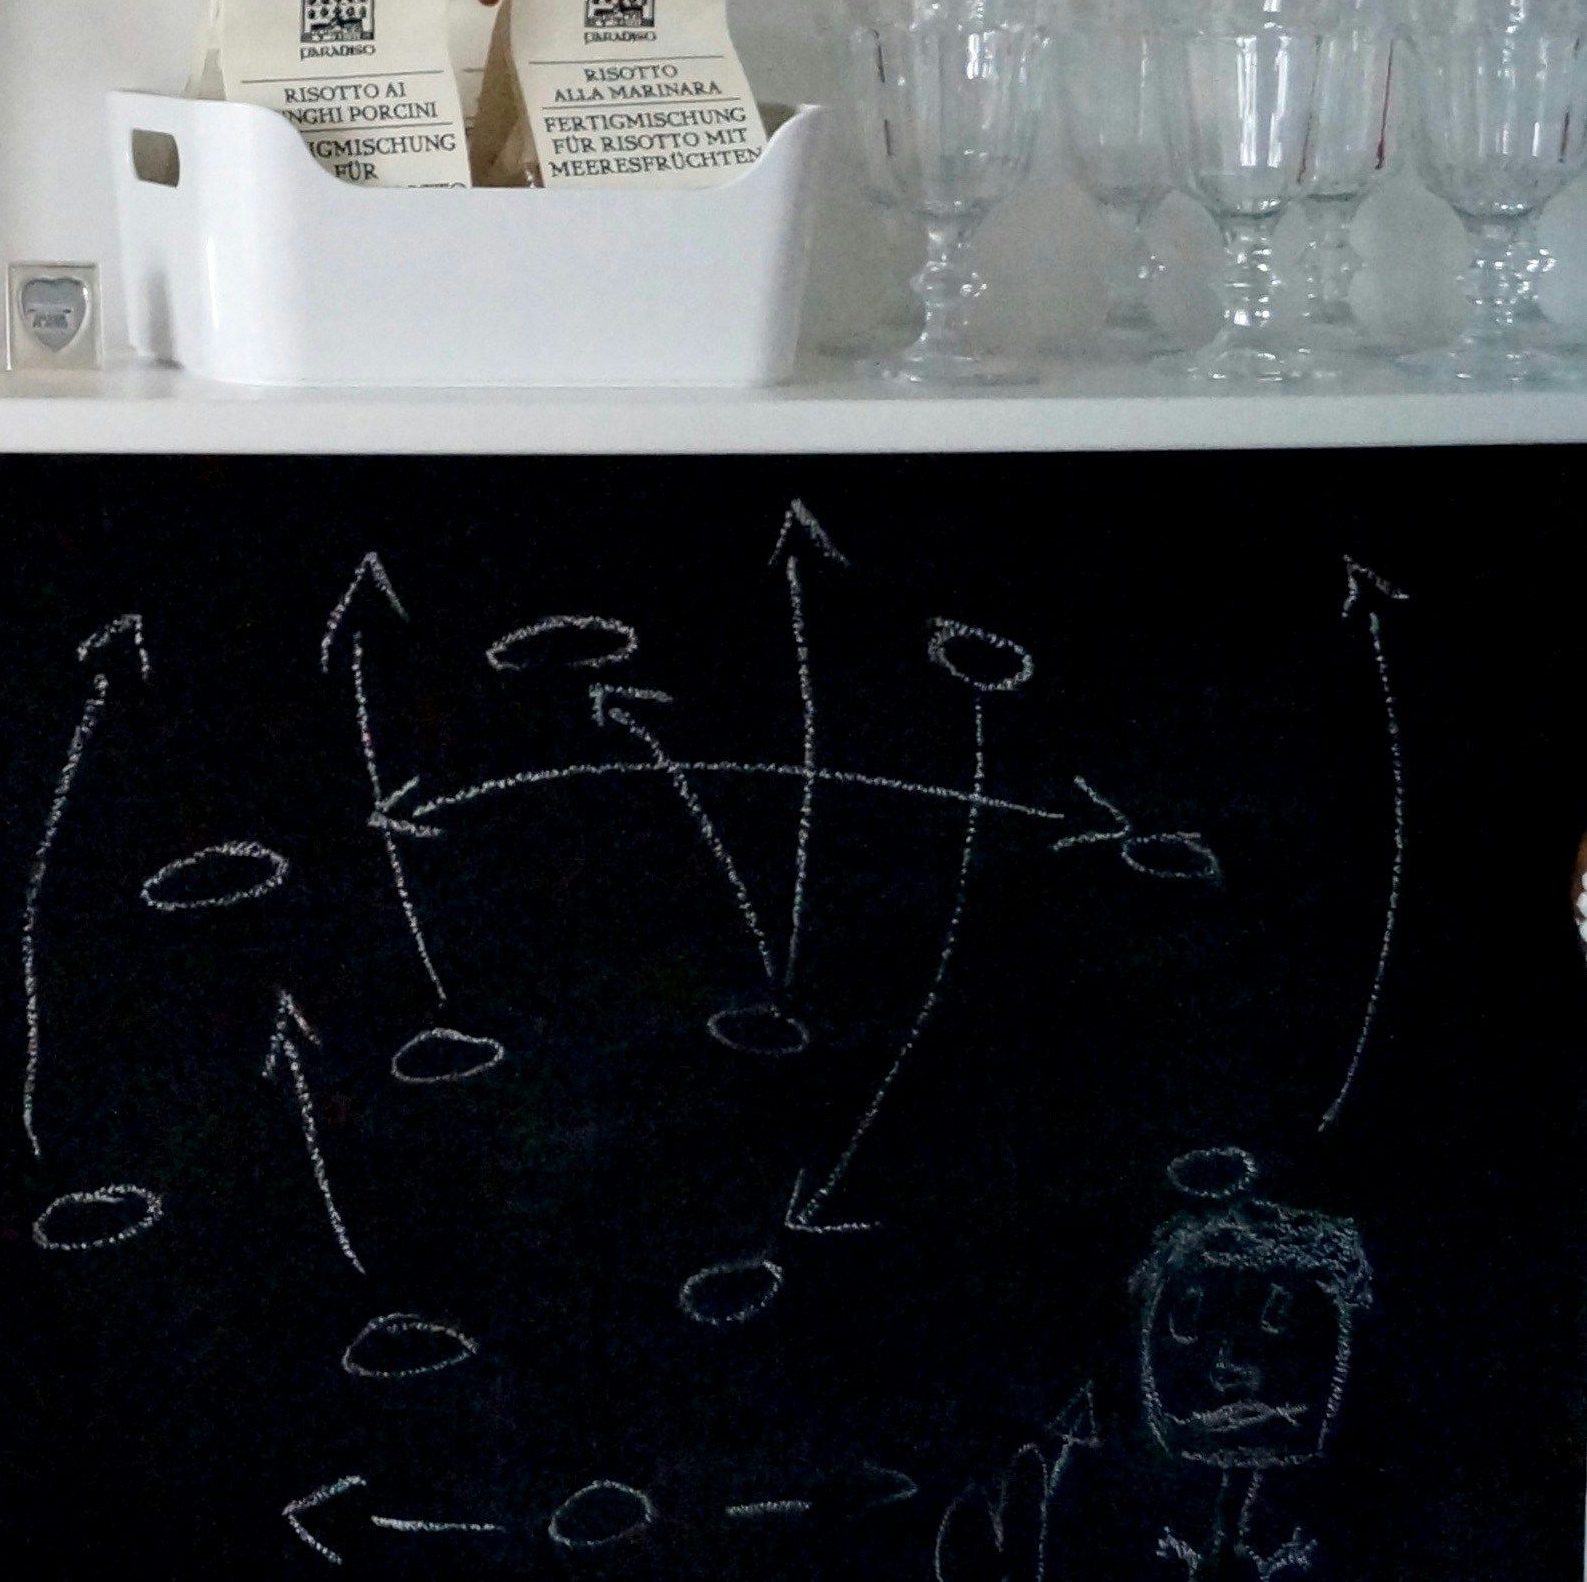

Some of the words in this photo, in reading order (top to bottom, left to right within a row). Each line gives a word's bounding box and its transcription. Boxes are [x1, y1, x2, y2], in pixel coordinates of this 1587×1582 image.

[583, 63, 679, 83] RISOTTO
[283, 82, 380, 105] RISOTTO
[384, 81, 407, 99] AI
[554, 84, 605, 103] ALLA
[607, 80, 724, 102] MARINARA
[282, 104, 342, 126] NGHI
[348, 100, 439, 123] PORCINI
[543, 106, 747, 134] FERTIGMISCHUNG
[305, 132, 457, 159] IGMISCHUNG
[551, 133, 597, 156] FÜR
[600, 130, 702, 154] RISOTTO
[705, 127, 748, 147] MIT
[333, 159, 379, 181] FÜR
[547, 146, 764, 178] MEERESFRÜCHTEN
